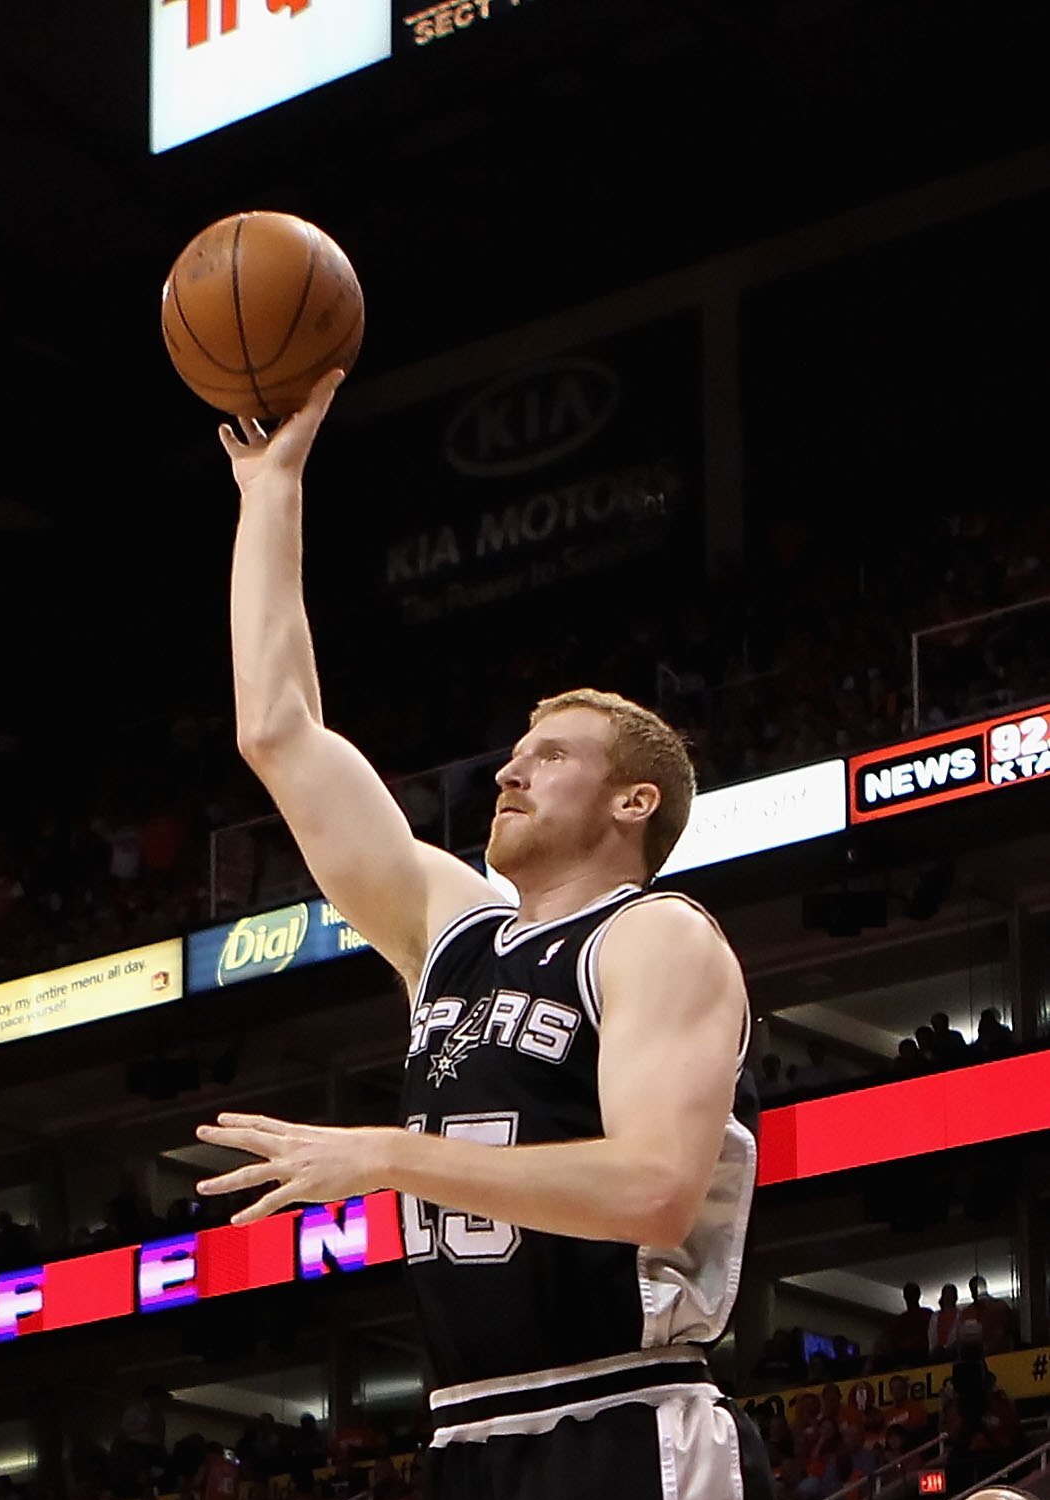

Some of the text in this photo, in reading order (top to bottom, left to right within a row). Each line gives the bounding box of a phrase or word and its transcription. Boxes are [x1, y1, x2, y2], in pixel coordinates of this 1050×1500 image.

[476, 375, 593, 460] KIA
[386, 524, 462, 586] KIA
[474, 466, 680, 558] MOTO
[864, 747, 977, 803] NEWS
[224, 916, 300, 971] Dial
[15, 997, 31, 1013] my
[35, 984, 68, 1004] entire
[71, 975, 104, 993] menu
[107, 965, 121, 981] all
[0, 1014, 25, 1031] pace
